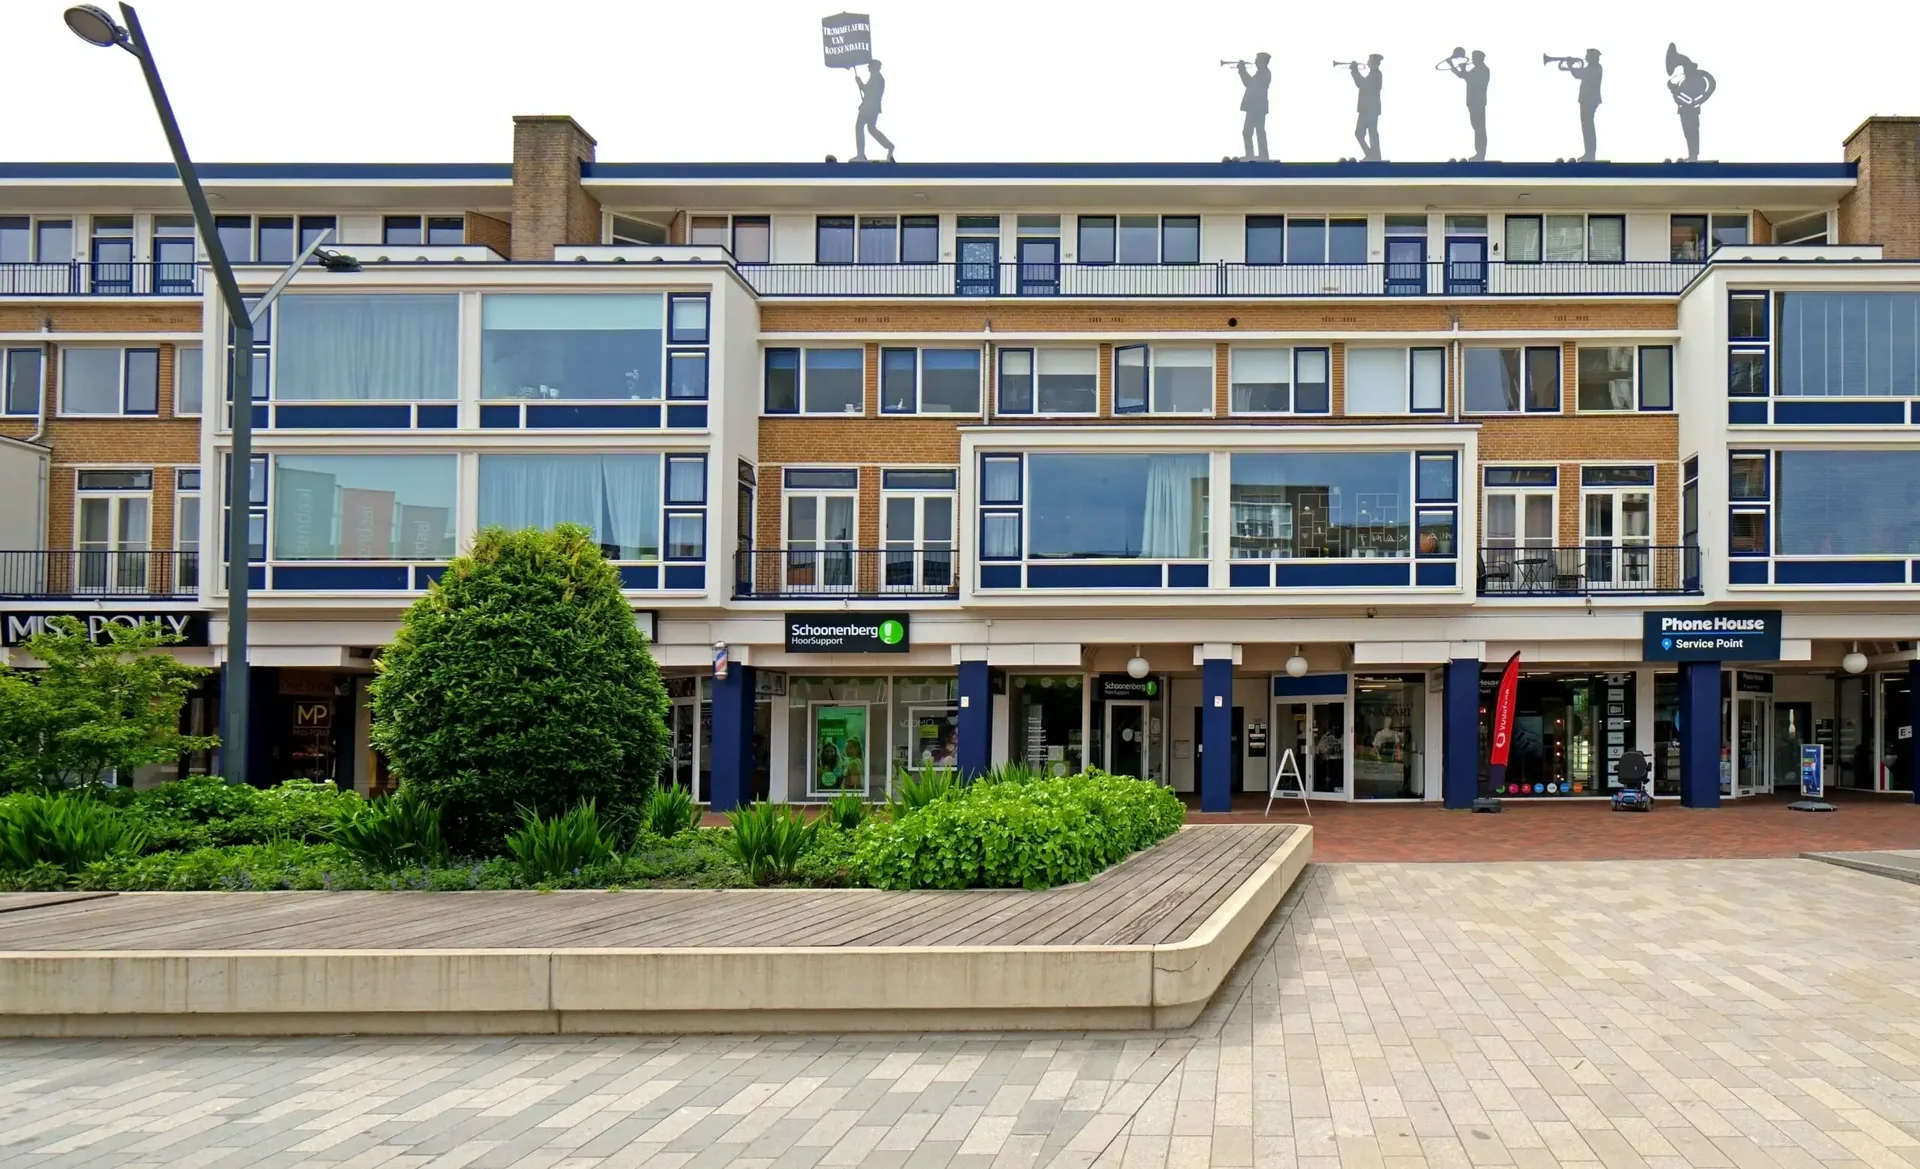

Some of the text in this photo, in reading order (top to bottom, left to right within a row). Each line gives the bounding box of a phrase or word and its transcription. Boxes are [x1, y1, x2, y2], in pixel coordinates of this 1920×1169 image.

[8, 615, 80, 643] MIS
[791, 624, 878, 638] Schoonenberg
[1661, 617, 1764, 631] Phone House
[791, 637, 843, 646] HoorSupport
[1675, 639, 1743, 648] Service Point
[1104, 681, 1146, 692] Schoonenberg
[297, 704, 328, 725] MP
